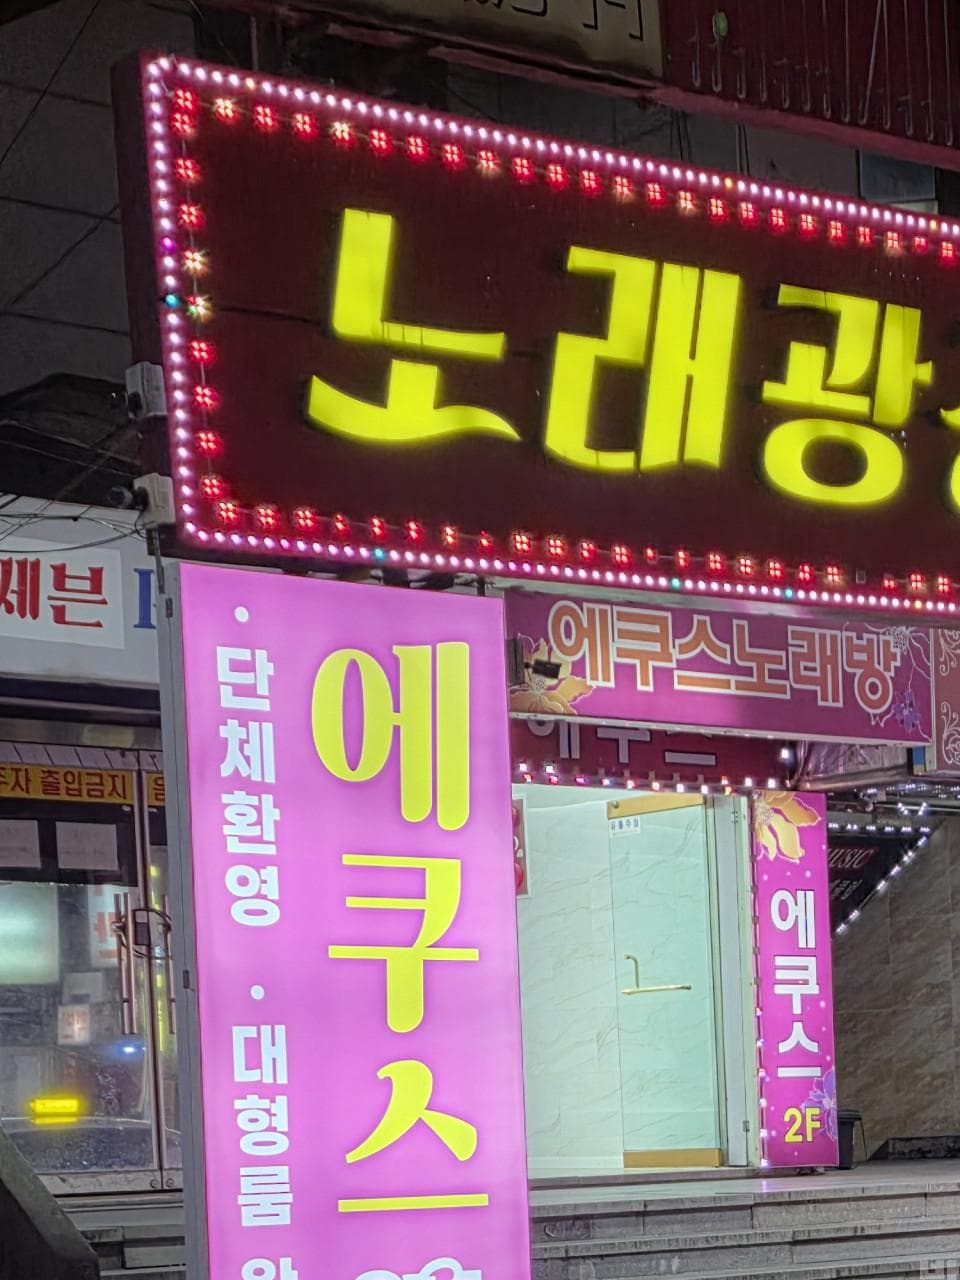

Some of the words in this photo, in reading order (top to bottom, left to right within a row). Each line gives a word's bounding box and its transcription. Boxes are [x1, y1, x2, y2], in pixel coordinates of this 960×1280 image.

[548, 600, 901, 715] 에쿠스노래방
[40, 768, 127, 800] 출입금지
[216, 644, 281, 928] 단체환영
[310, 641, 490, 1213] 에쿠스
[769, 889, 822, 1078] 에쿠스
[231, 1023, 294, 1228] 대형룸
[783, 1107, 822, 1143] 2F
